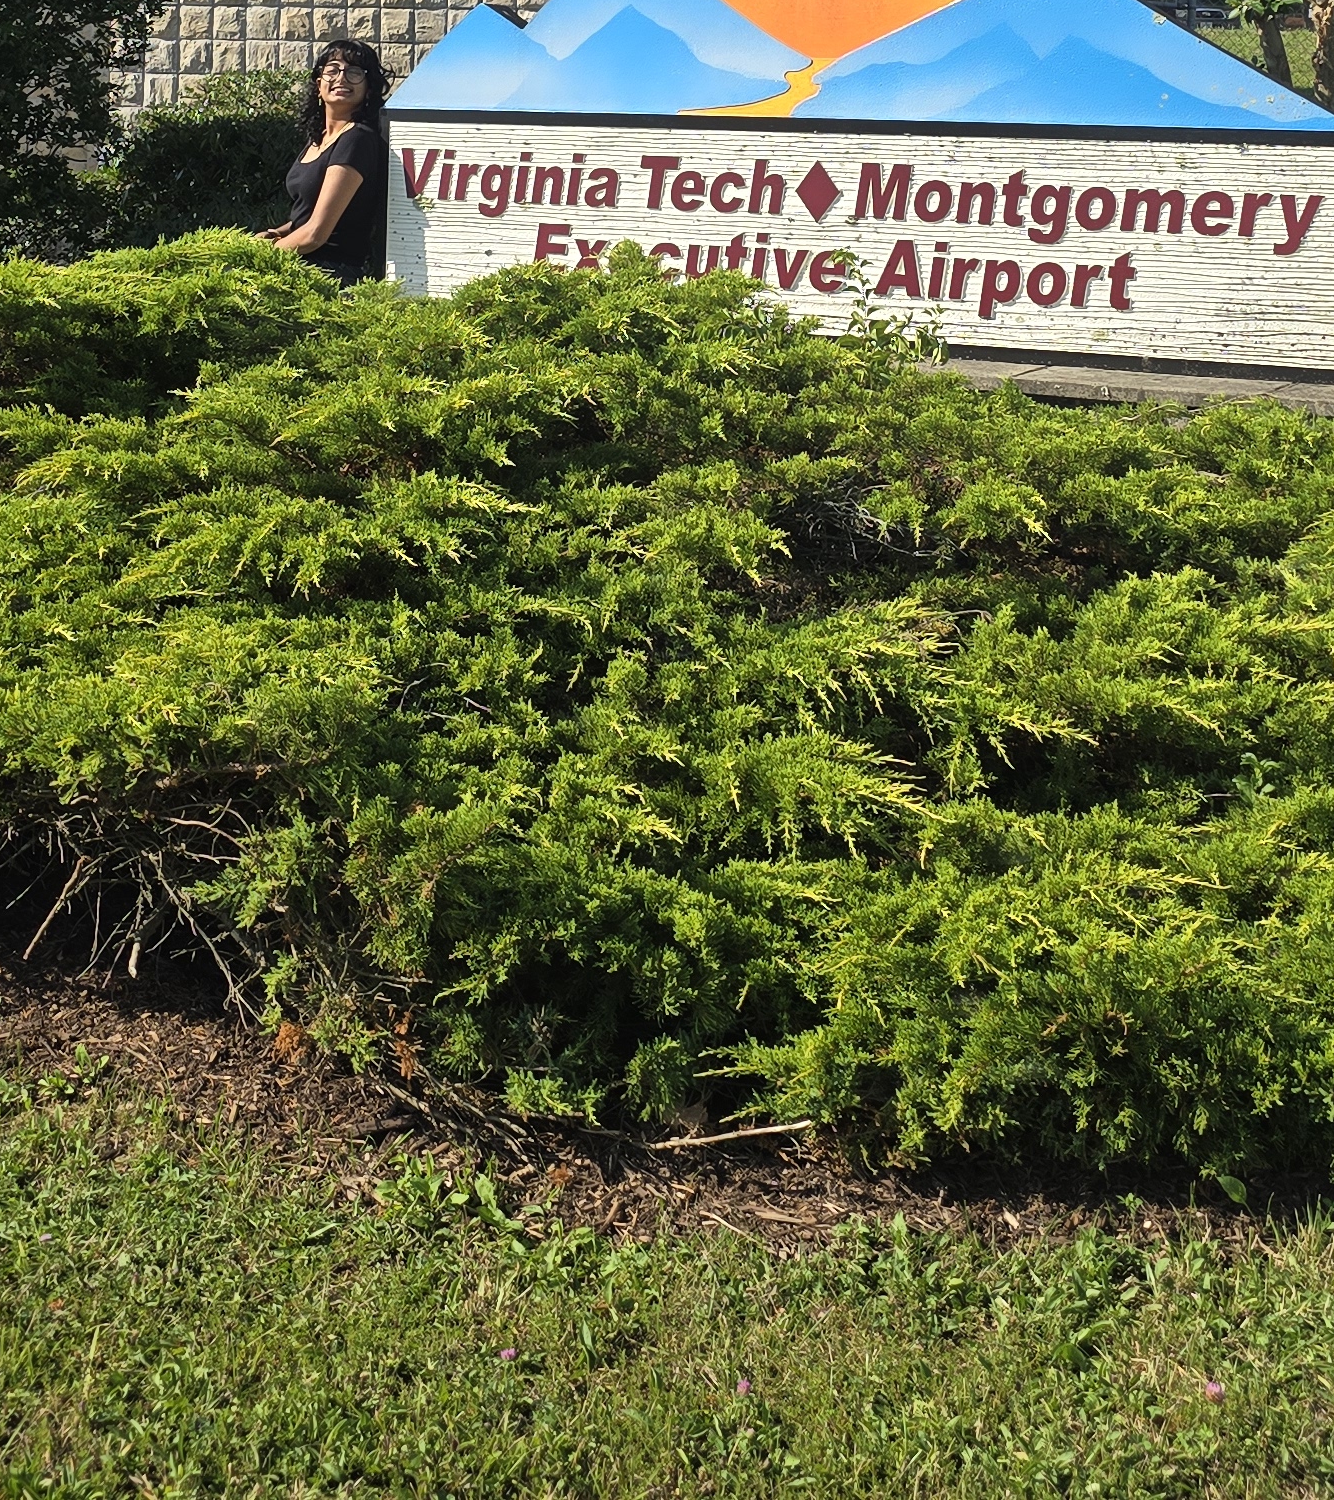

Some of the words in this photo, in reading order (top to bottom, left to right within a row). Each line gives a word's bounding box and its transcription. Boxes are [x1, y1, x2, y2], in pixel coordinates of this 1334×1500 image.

[401, 148, 620, 218] Virginia
[640, 155, 786, 215] Tech
[854, 162, 1326, 256] Montgomery
[534, 223, 849, 293] Excutive
[873, 239, 1138, 320] Airport
